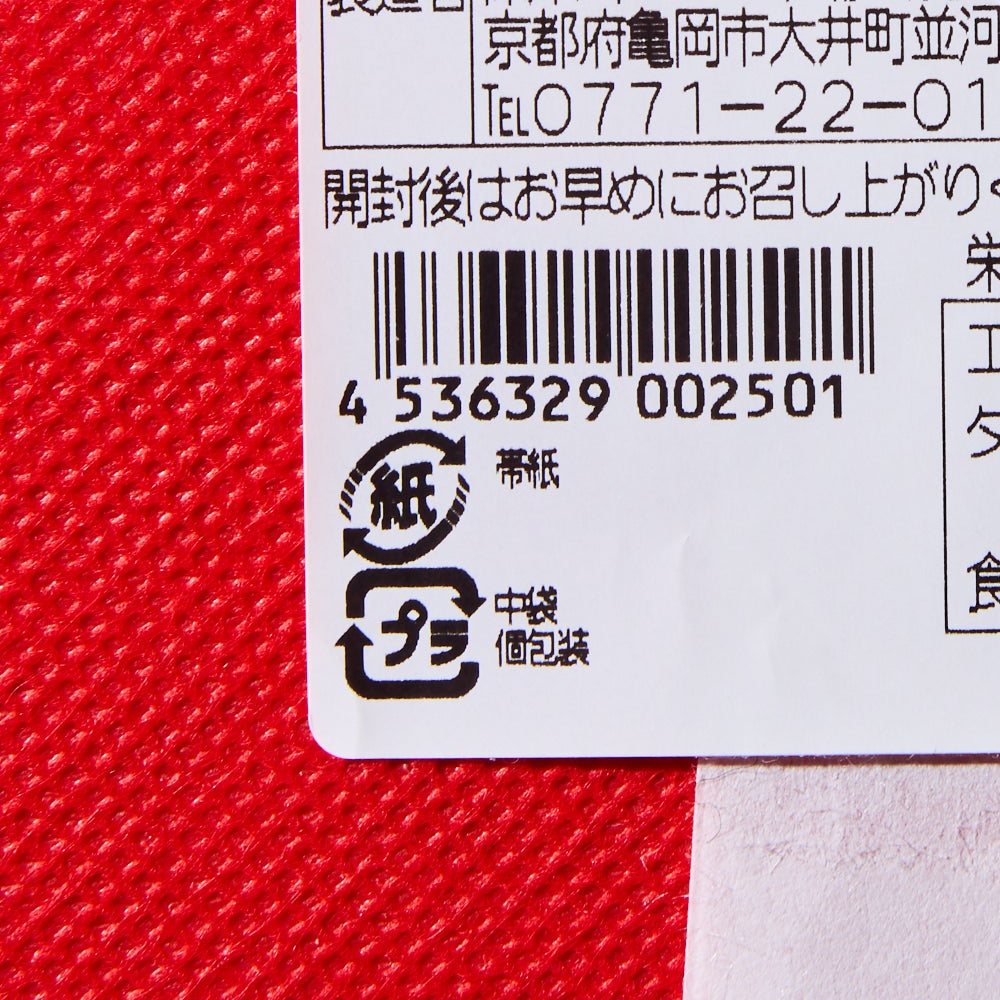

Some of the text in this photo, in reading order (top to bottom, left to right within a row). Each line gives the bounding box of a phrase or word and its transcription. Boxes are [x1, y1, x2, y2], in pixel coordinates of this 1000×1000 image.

[339, 372, 842, 424] 4 536329 002501
[496, 448, 559, 489] 帯紙
[495, 586, 557, 625] 中袋
[496, 628, 589, 666] 個包装
